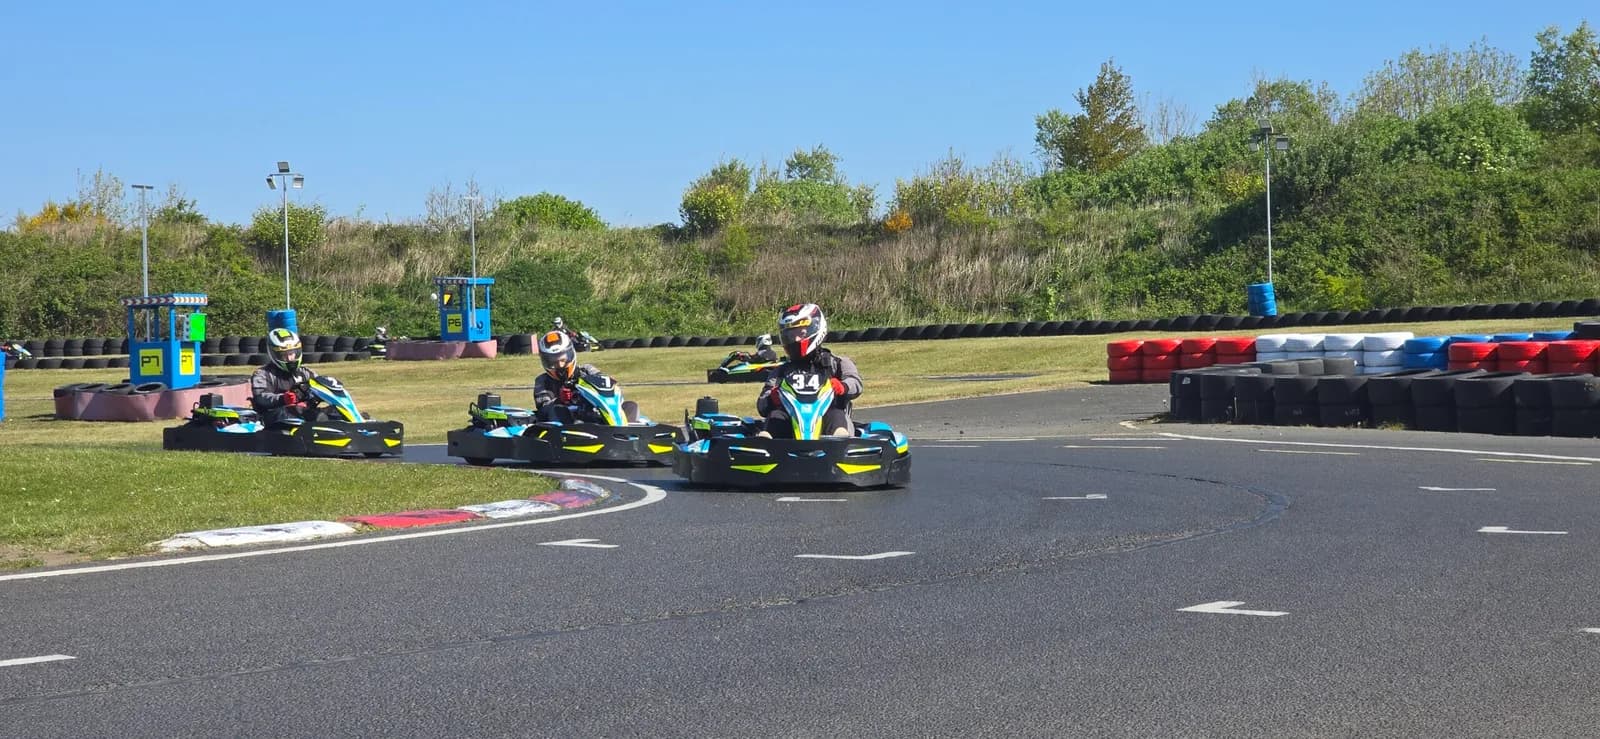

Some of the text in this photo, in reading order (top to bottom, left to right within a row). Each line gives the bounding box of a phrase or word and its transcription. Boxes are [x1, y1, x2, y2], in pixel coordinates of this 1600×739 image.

[448, 318, 461, 327] P6
[141, 355, 160, 367] P7
[792, 374, 820, 390] 34
